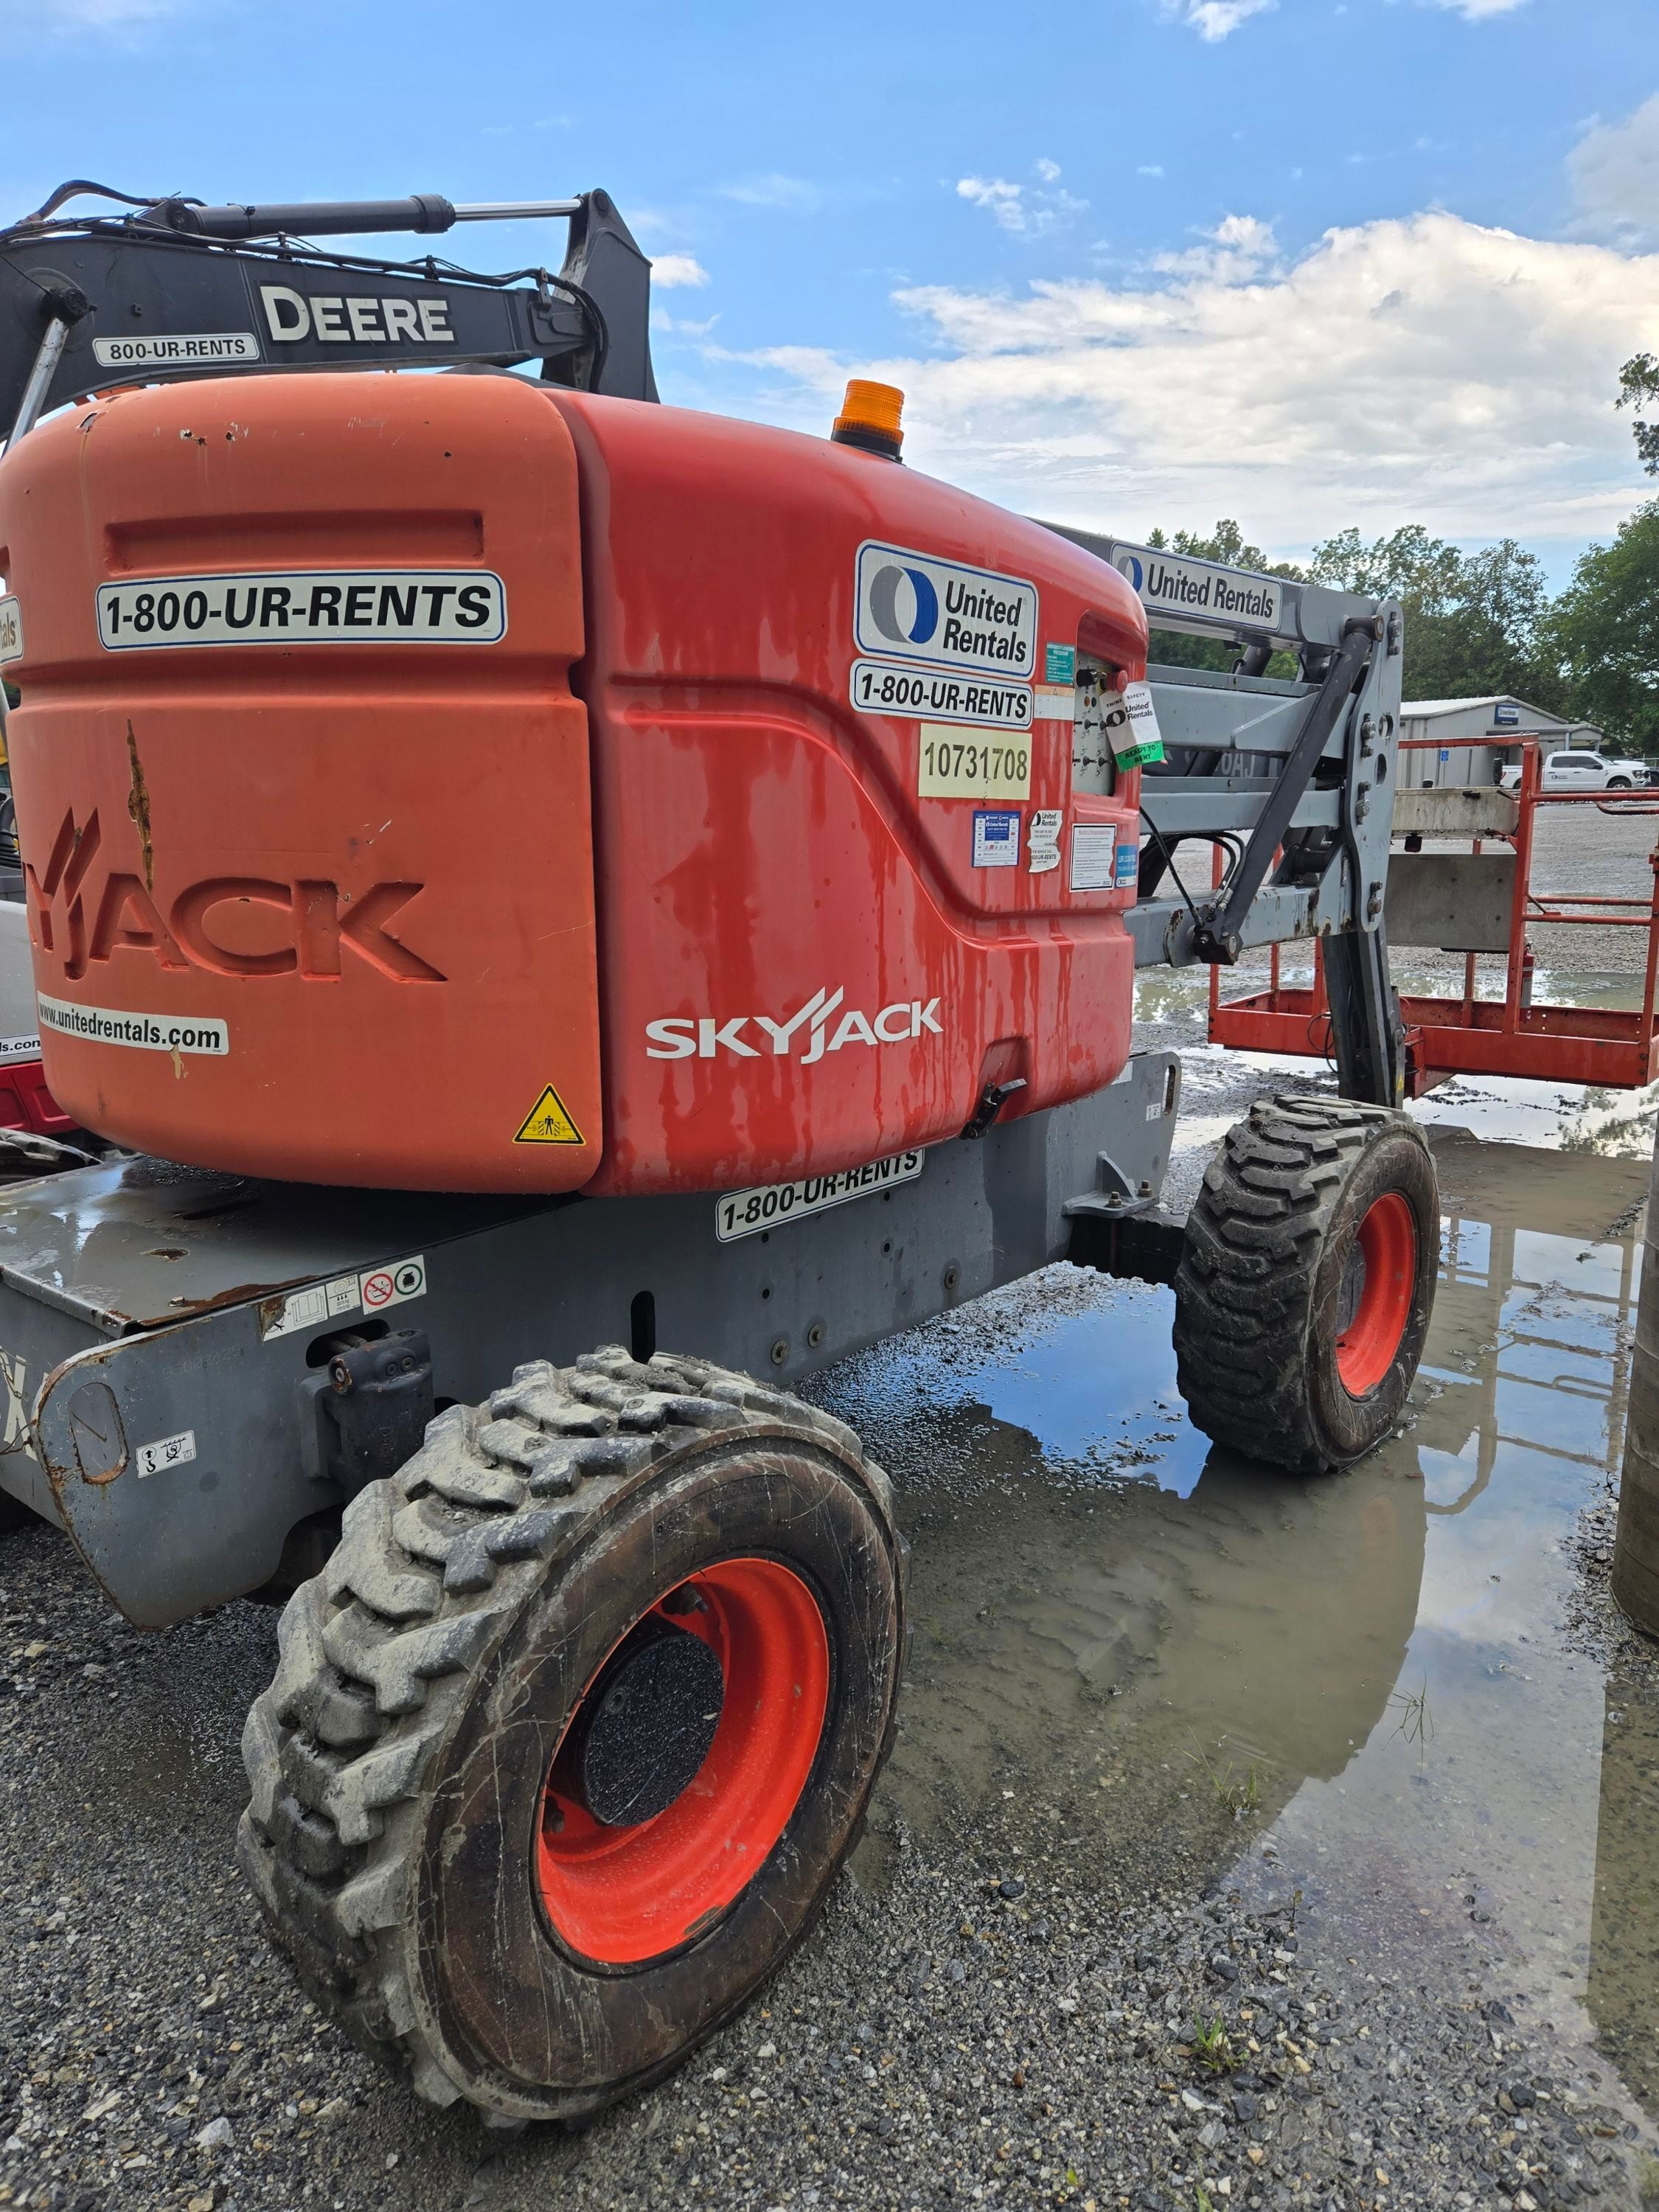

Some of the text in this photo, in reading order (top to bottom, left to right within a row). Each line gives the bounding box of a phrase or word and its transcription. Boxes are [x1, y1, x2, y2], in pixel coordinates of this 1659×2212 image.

[260, 285, 454, 342] DEERE
[110, 338, 246, 361] 800-UR-RENTS
[107, 585, 492, 634] 1-800-UR-RENTS
[945, 580, 1023, 627] United
[1147, 563, 1273, 619] United Rentals
[0, 612, 16, 648] als
[943, 618, 1026, 662] Rentals
[861, 673, 1028, 719] 1-800-UR-RENTS
[1106, 698, 1122, 708] THINK
[1126, 701, 1150, 713] United
[1127, 709, 1153, 720] Rentals
[925, 742, 1028, 782] 10731708
[1125, 748, 1147, 759] READY
[1135, 754, 1151, 763] RENT
[39, 1003, 221, 1048] www.unitedrentals.com
[646, 985, 944, 1064] SKYJACK
[724, 1151, 917, 1231] 1-800-UR-RENTS
